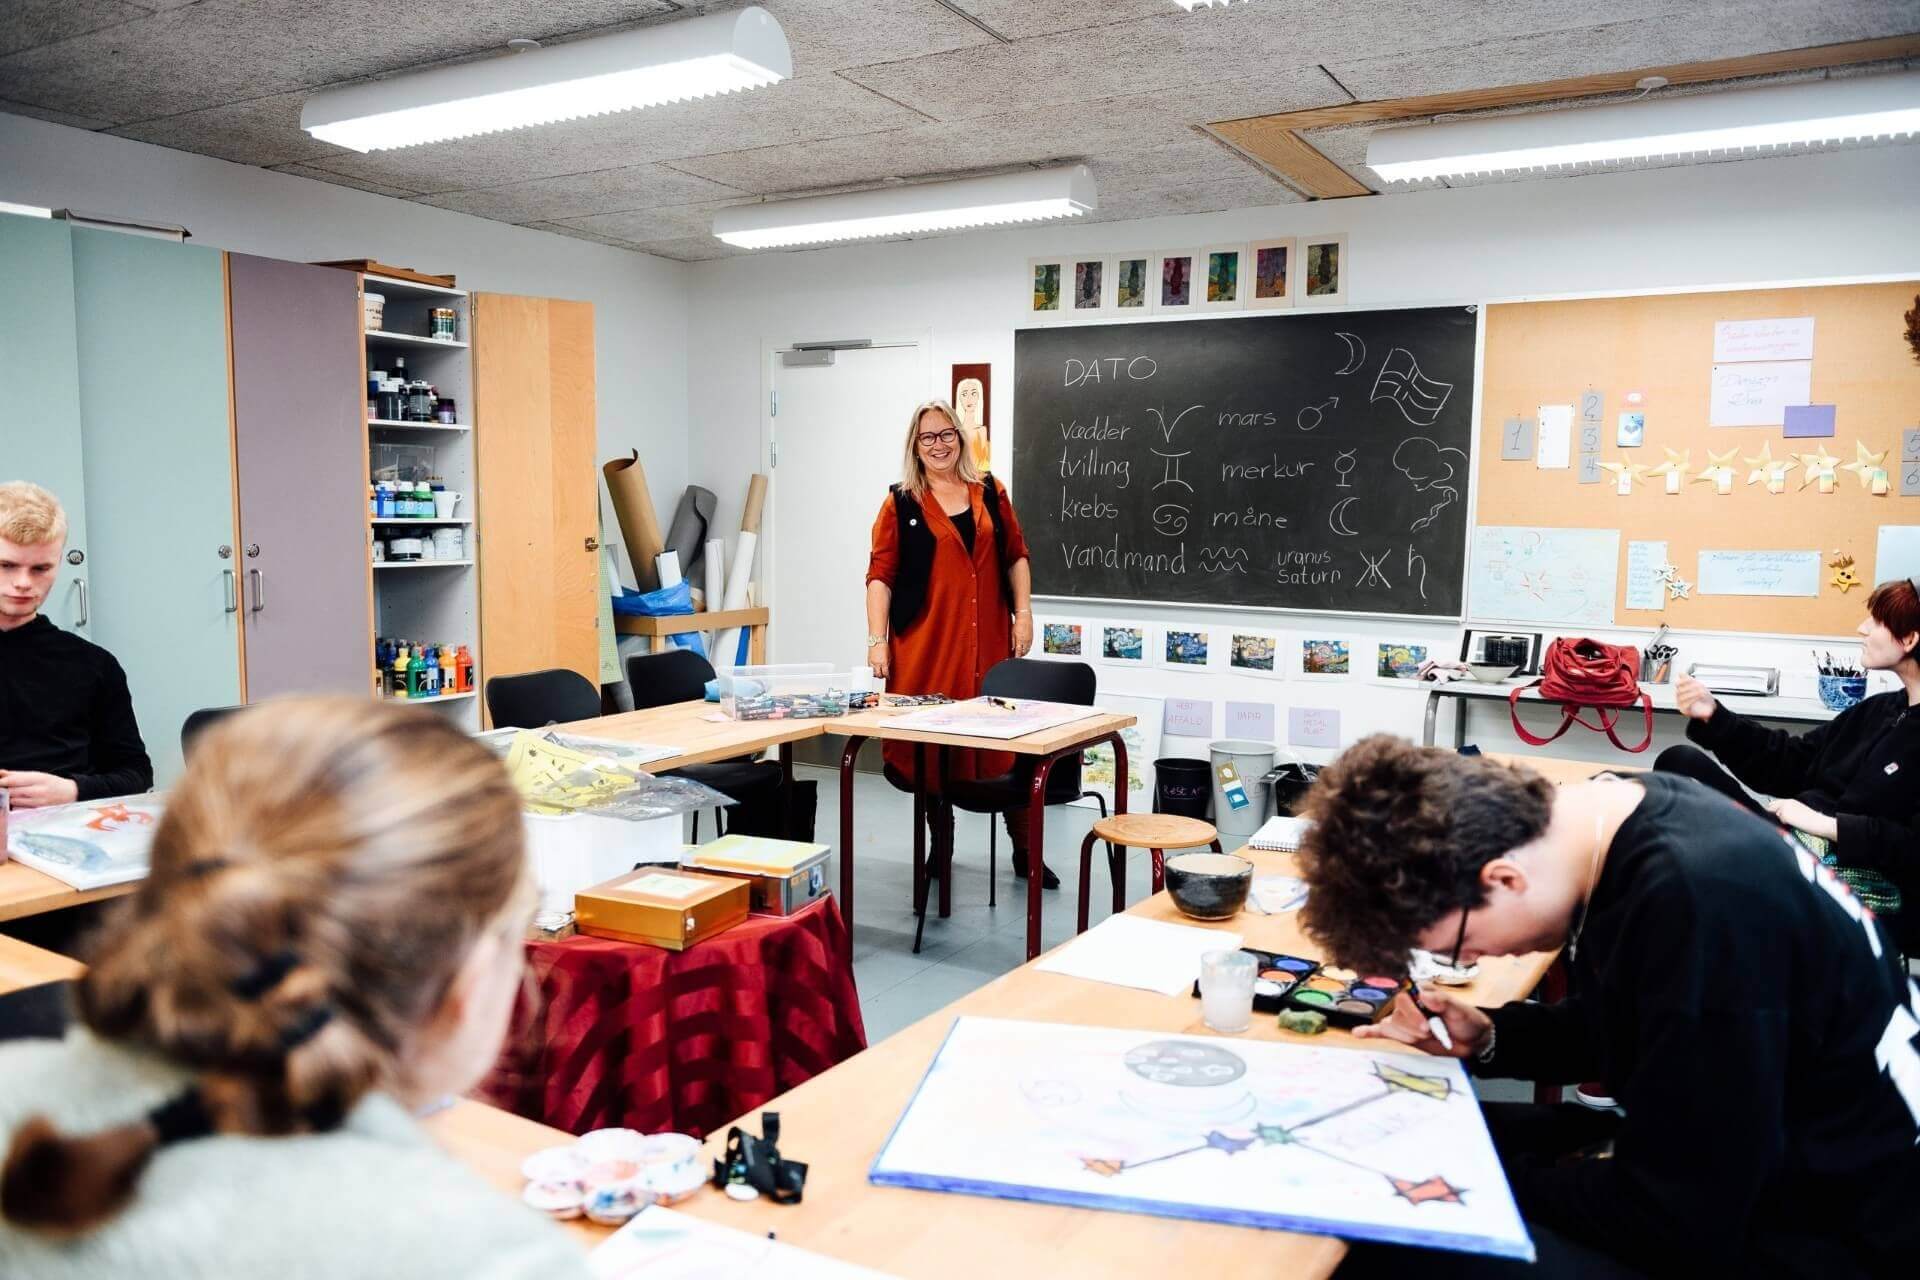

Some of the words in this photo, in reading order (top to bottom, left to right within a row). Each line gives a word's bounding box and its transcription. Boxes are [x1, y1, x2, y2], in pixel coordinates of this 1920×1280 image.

[1064, 356, 1157, 387] DATO
[1218, 411, 1277, 426] mars
[1584, 395, 1599, 417] 2
[1511, 423, 1522, 451] 1
[1583, 427, 1598, 447] 3
[1059, 445, 1130, 488] tvilling
[1222, 453, 1315, 482] merkur
[1061, 485, 1119, 523] krebs
[1212, 506, 1288, 529] måne
[1277, 550, 1332, 566] uranus
